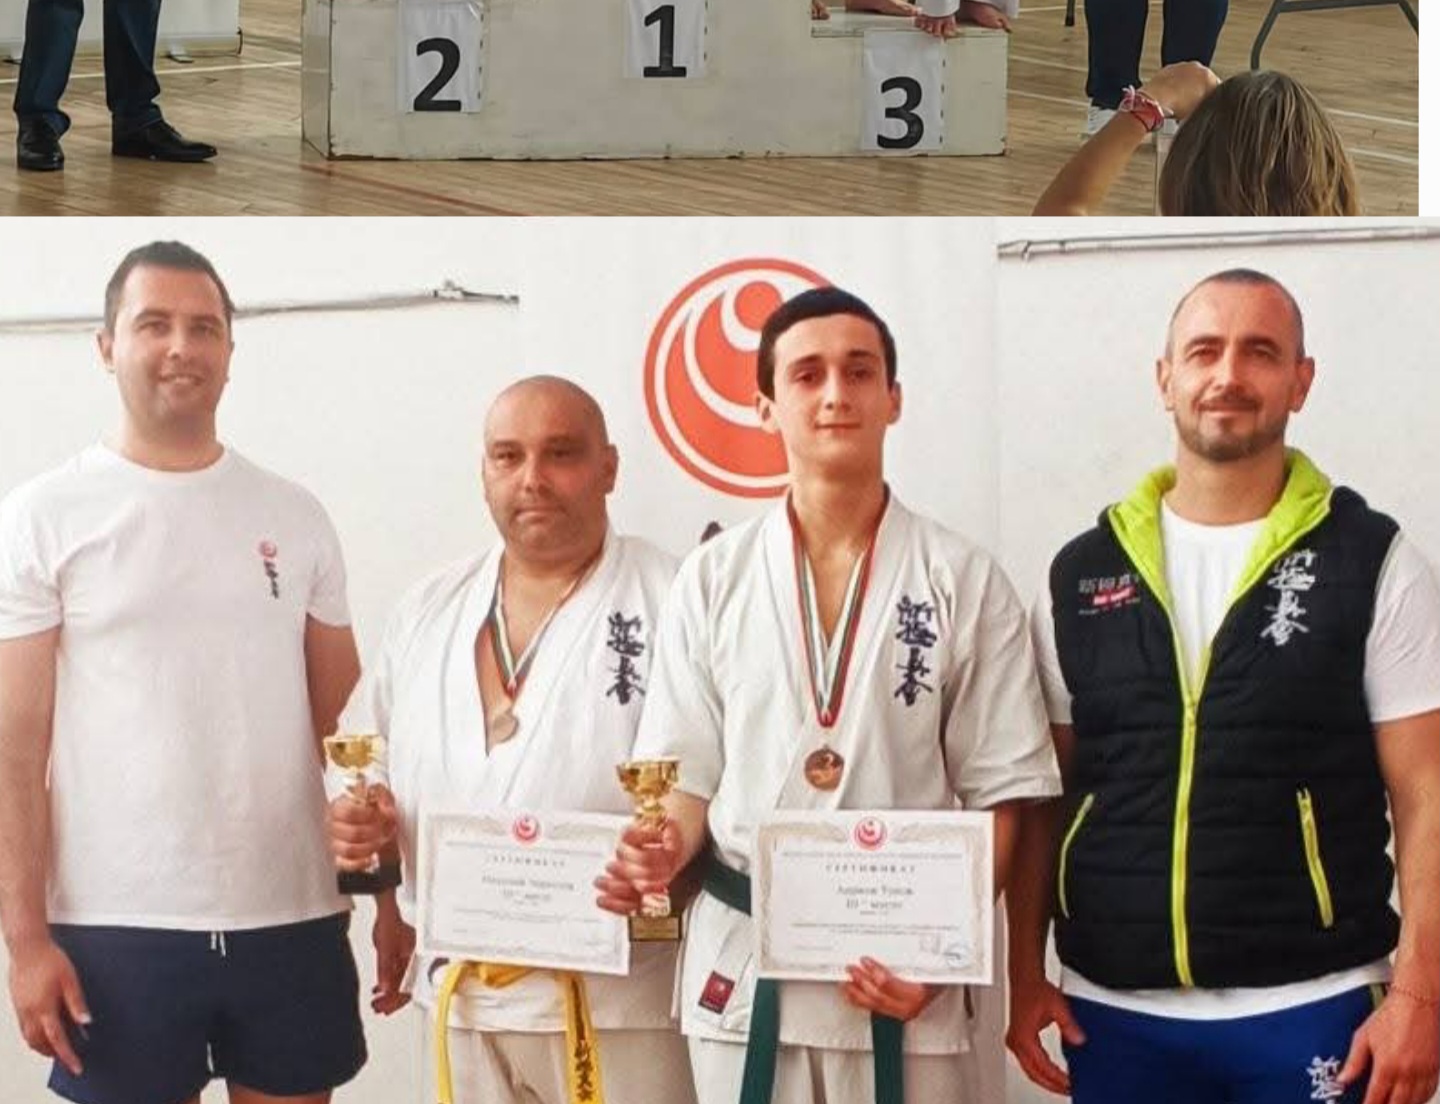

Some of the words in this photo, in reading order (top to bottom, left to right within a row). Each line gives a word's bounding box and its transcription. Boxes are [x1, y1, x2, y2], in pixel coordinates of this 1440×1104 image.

[413, 38, 462, 113] 2
[644, 5, 687, 78] 1
[877, 77, 925, 150] 3
